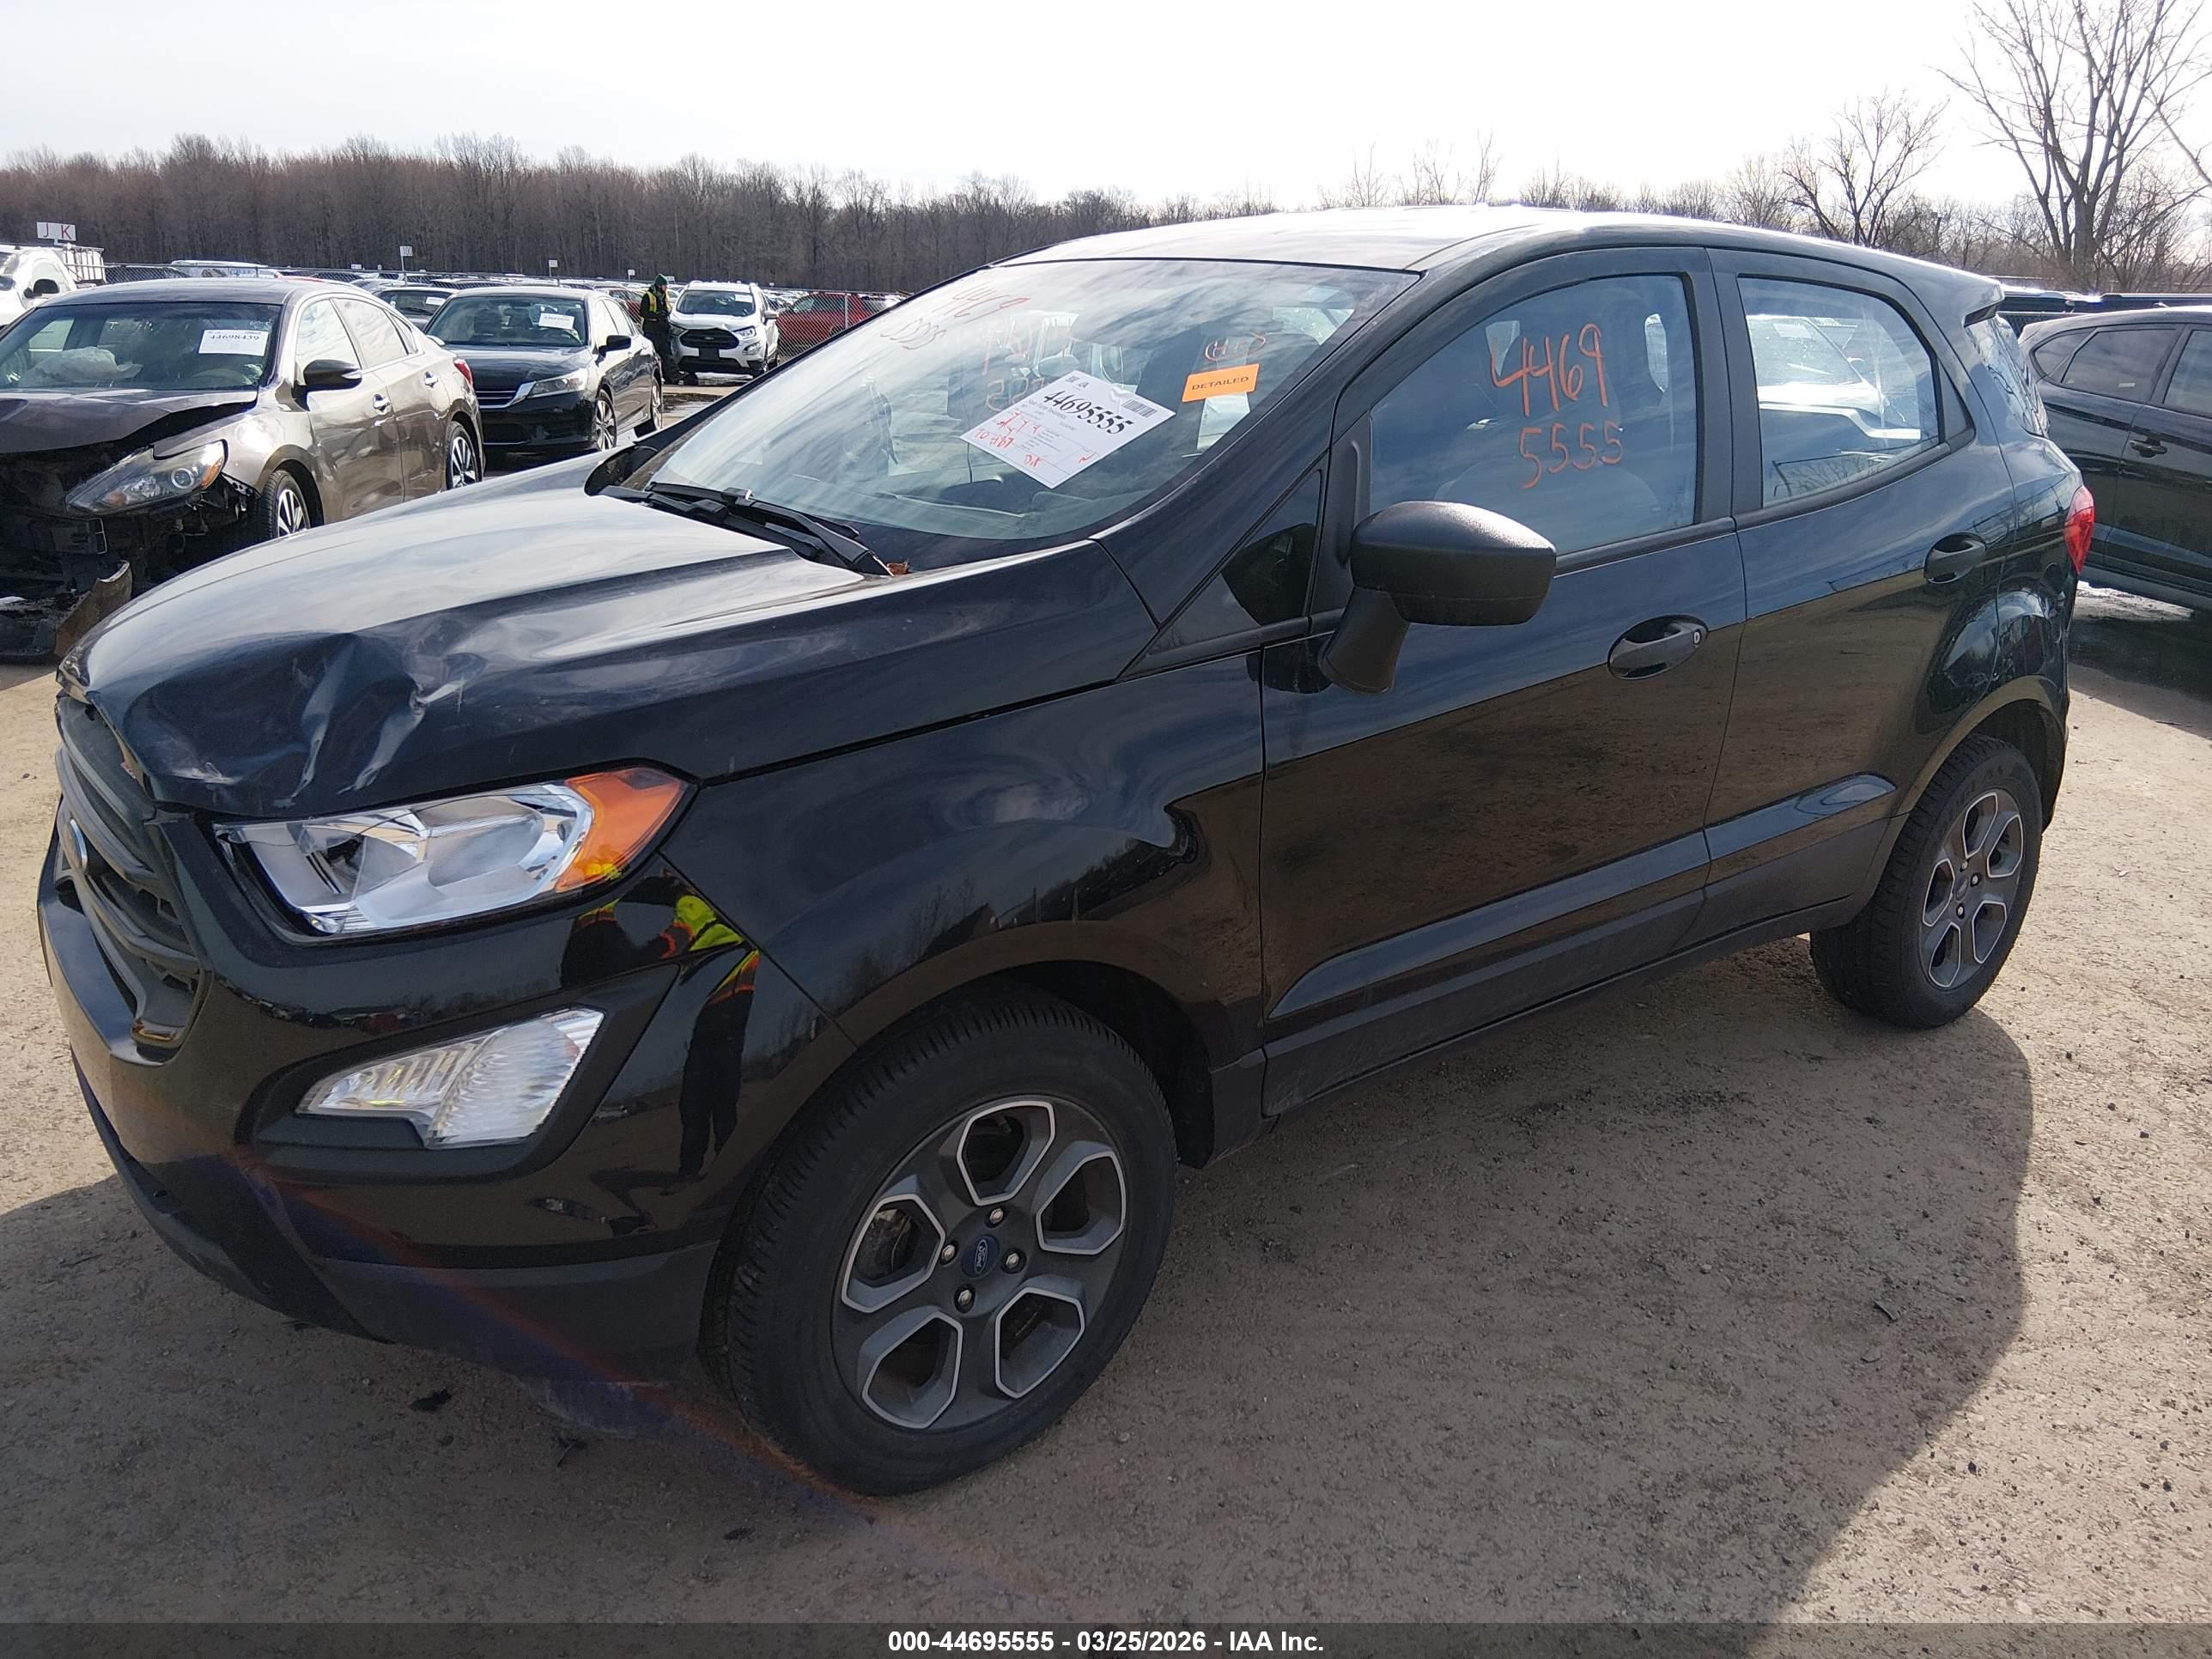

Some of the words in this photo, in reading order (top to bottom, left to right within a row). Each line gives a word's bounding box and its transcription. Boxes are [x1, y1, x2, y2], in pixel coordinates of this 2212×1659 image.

[43, 223, 49, 238] J
[61, 225, 71, 240] K
[1191, 376, 1249, 391] DETAILED
[1490, 323, 1608, 417] 4469
[1044, 391, 1133, 434] 44695555
[1519, 421, 1622, 489] 5555
